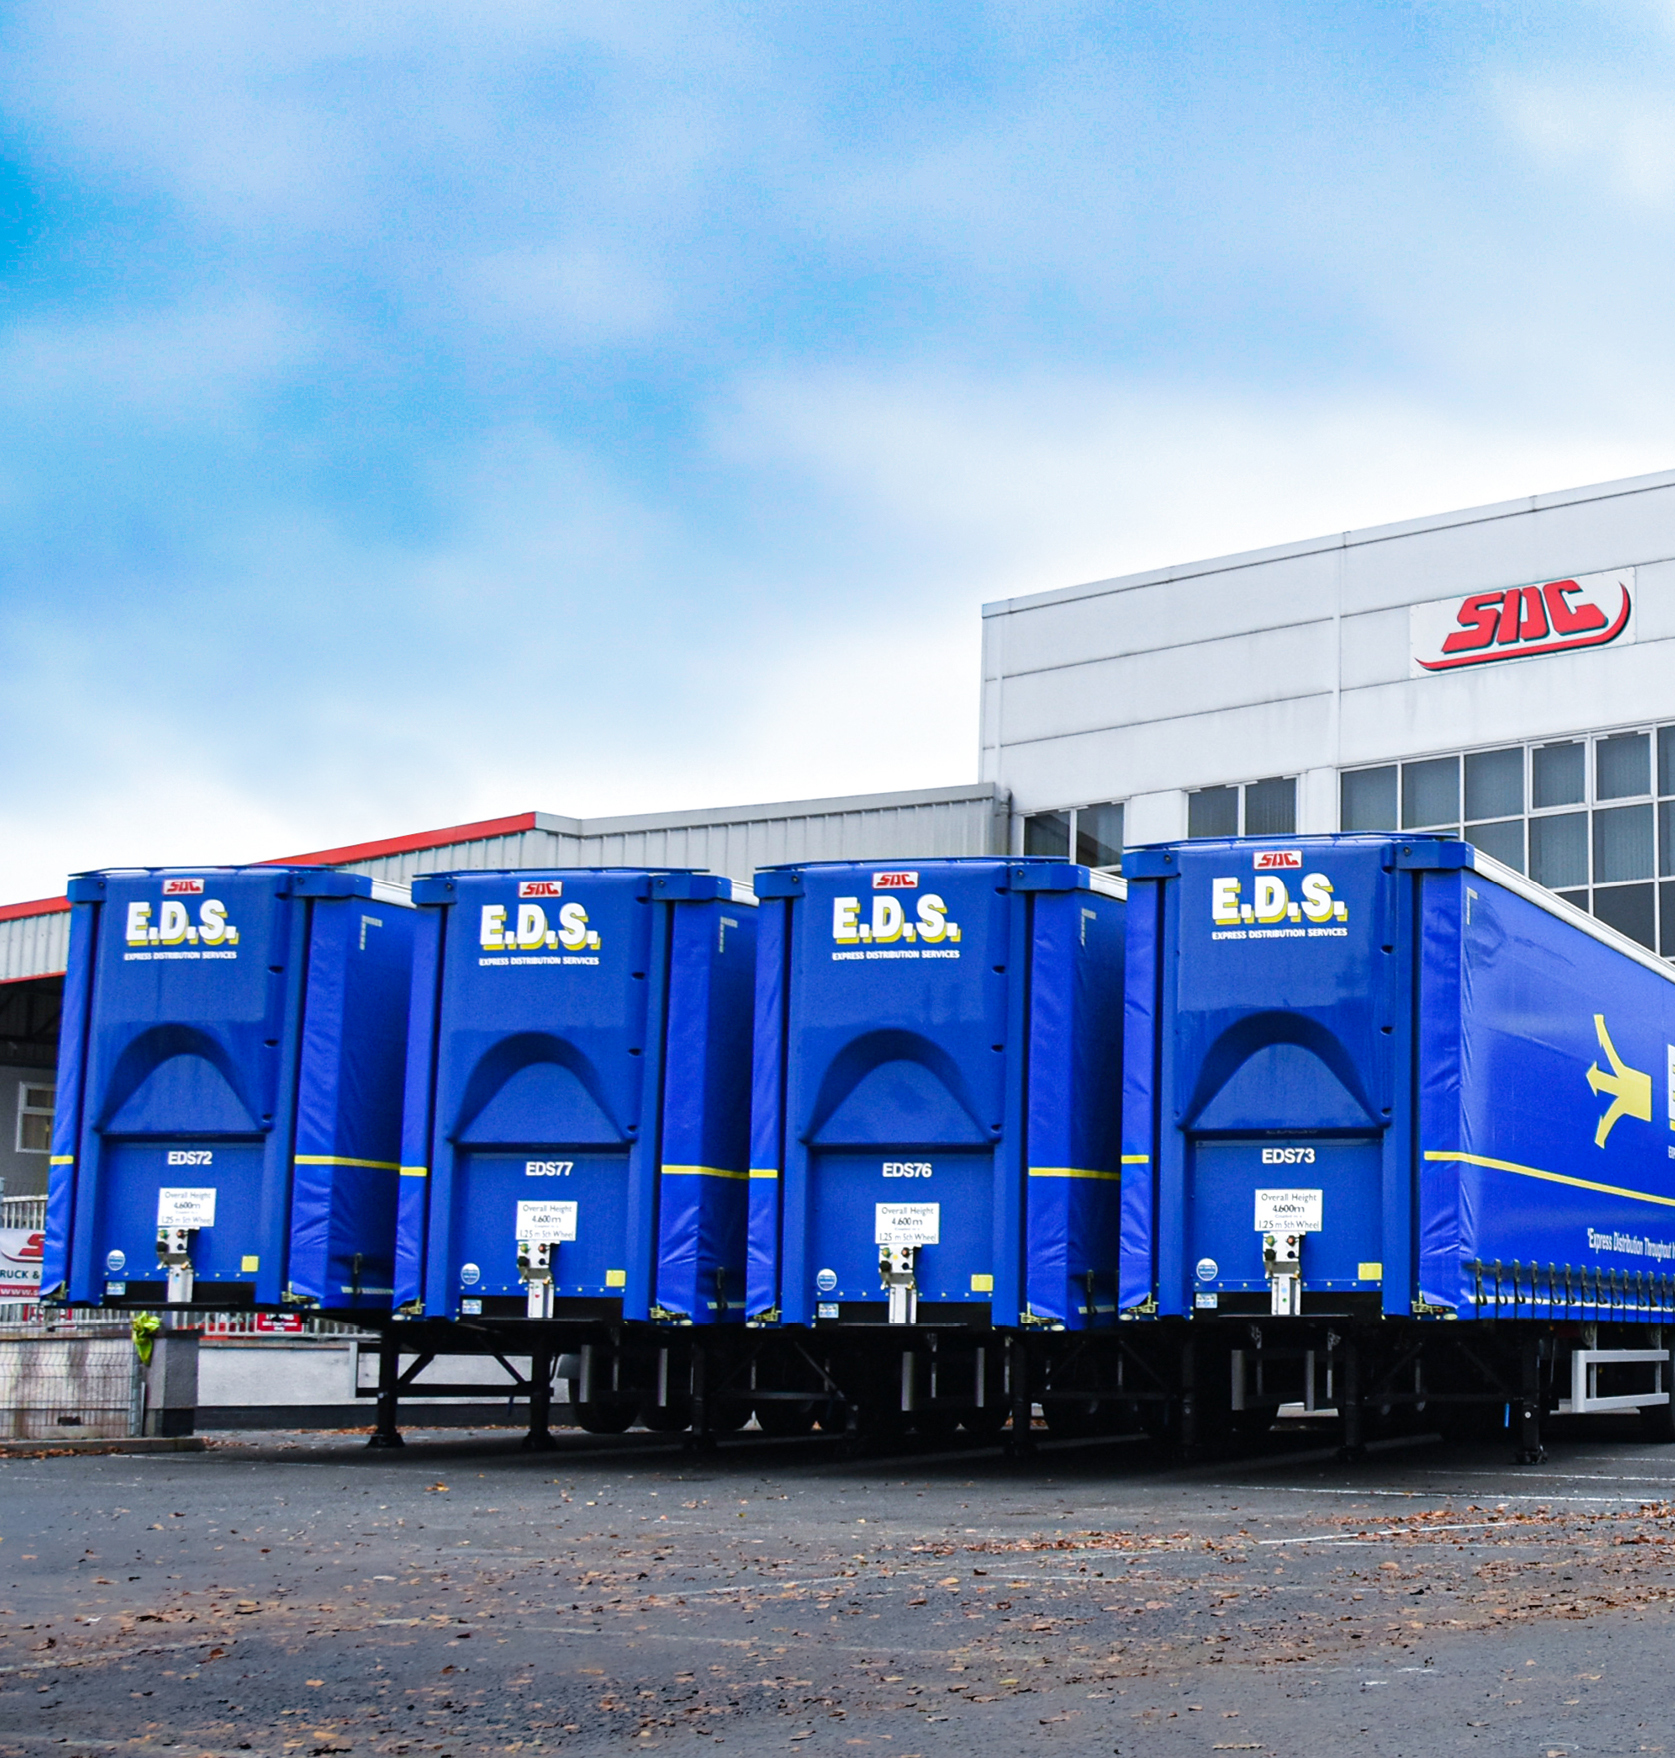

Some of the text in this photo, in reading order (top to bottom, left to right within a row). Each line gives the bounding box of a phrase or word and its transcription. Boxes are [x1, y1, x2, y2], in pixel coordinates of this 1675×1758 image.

[1440, 579, 1609, 655] SDC
[1212, 873, 1348, 925] E.D.S.
[126, 899, 239, 946] E.D.S.
[480, 902, 601, 950] E.D.S.
[833, 894, 962, 944] E.D.S.
[1212, 927, 1348, 940] EXPRESS DISTRIBUTION SERVICES
[168, 1151, 213, 1165] EDS72
[1262, 1147, 1316, 1164] EDS73
[525, 1161, 574, 1176] EDS77
[882, 1162, 933, 1178] EDS76
[1261, 1193, 1317, 1203] Overall Height
[1613, 1231, 1644, 1255] Distribution
[1644, 1236, 1671, 1263] Throughout
[32, 1271, 40, 1279] &
